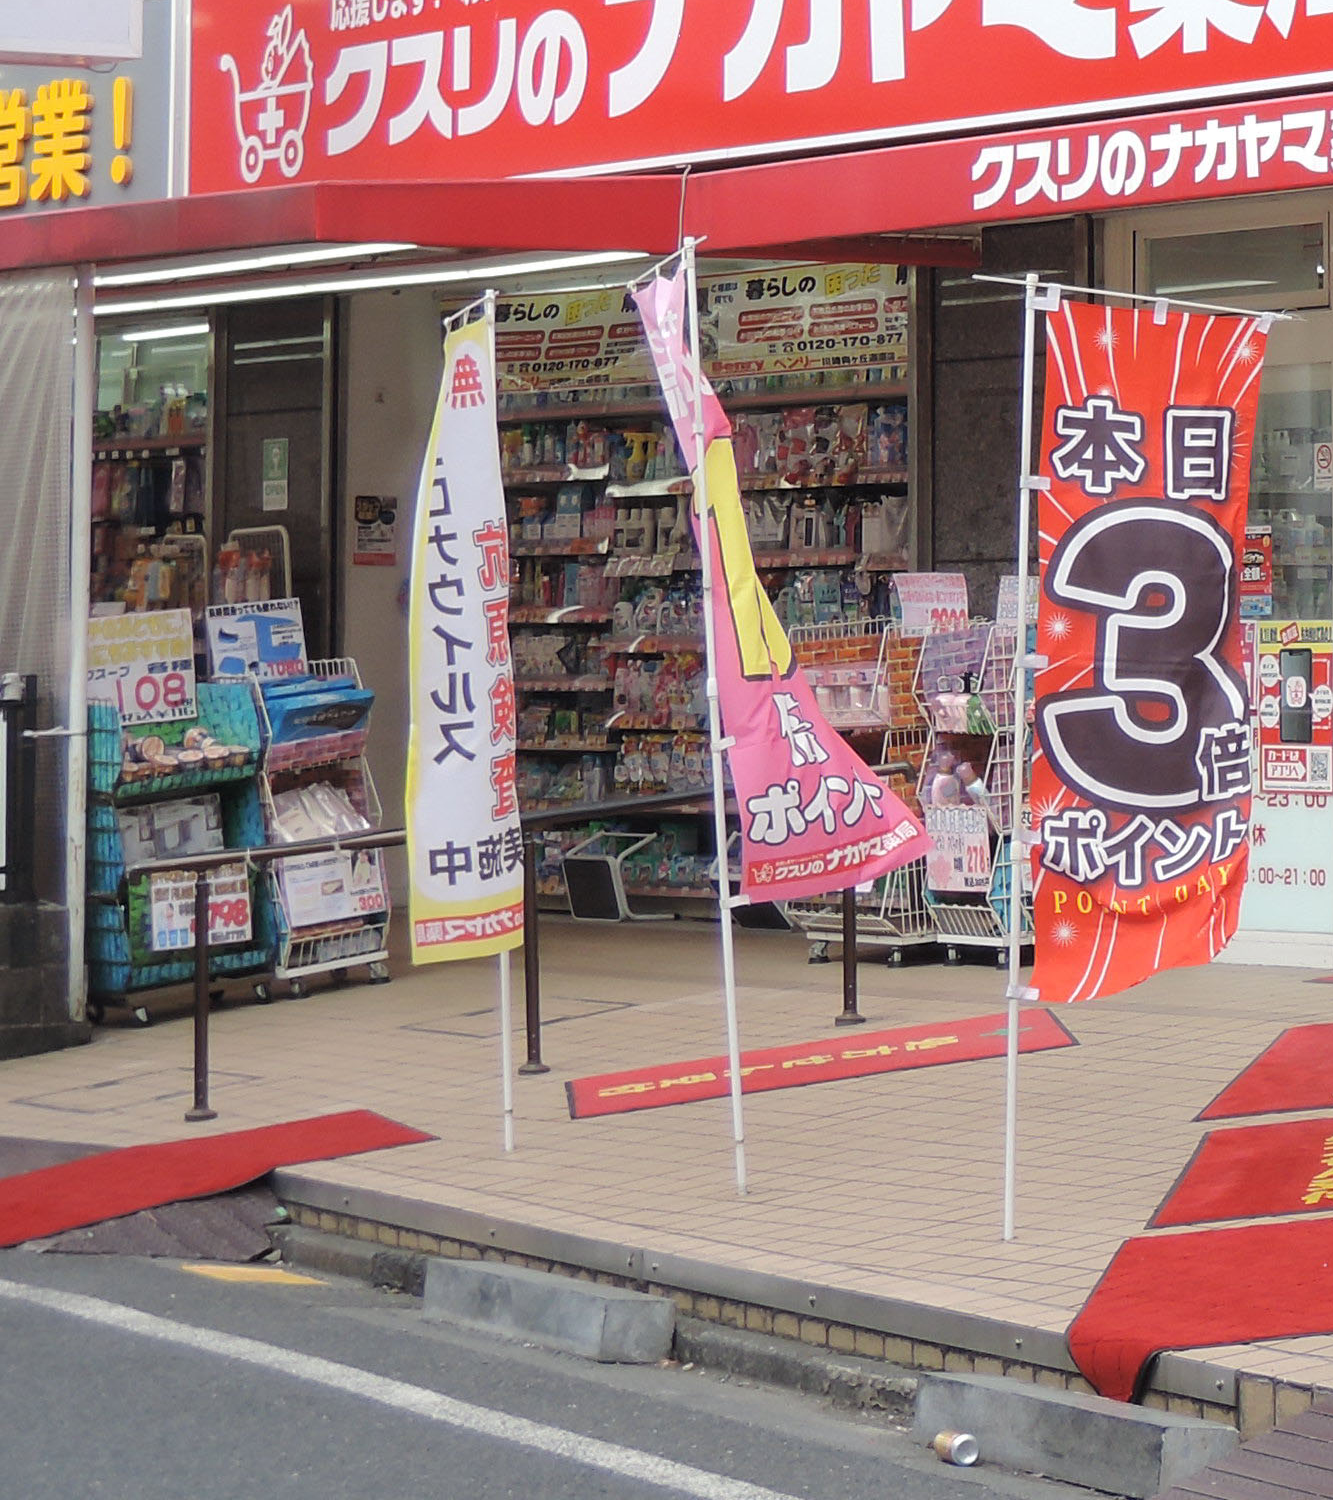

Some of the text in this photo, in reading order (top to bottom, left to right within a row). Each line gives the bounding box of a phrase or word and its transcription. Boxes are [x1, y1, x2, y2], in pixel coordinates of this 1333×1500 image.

[1050, 398, 1235, 500] 本日
[1041, 807, 1248, 886] ポイント
[1244, 867, 1326, 887] :00~21:00
